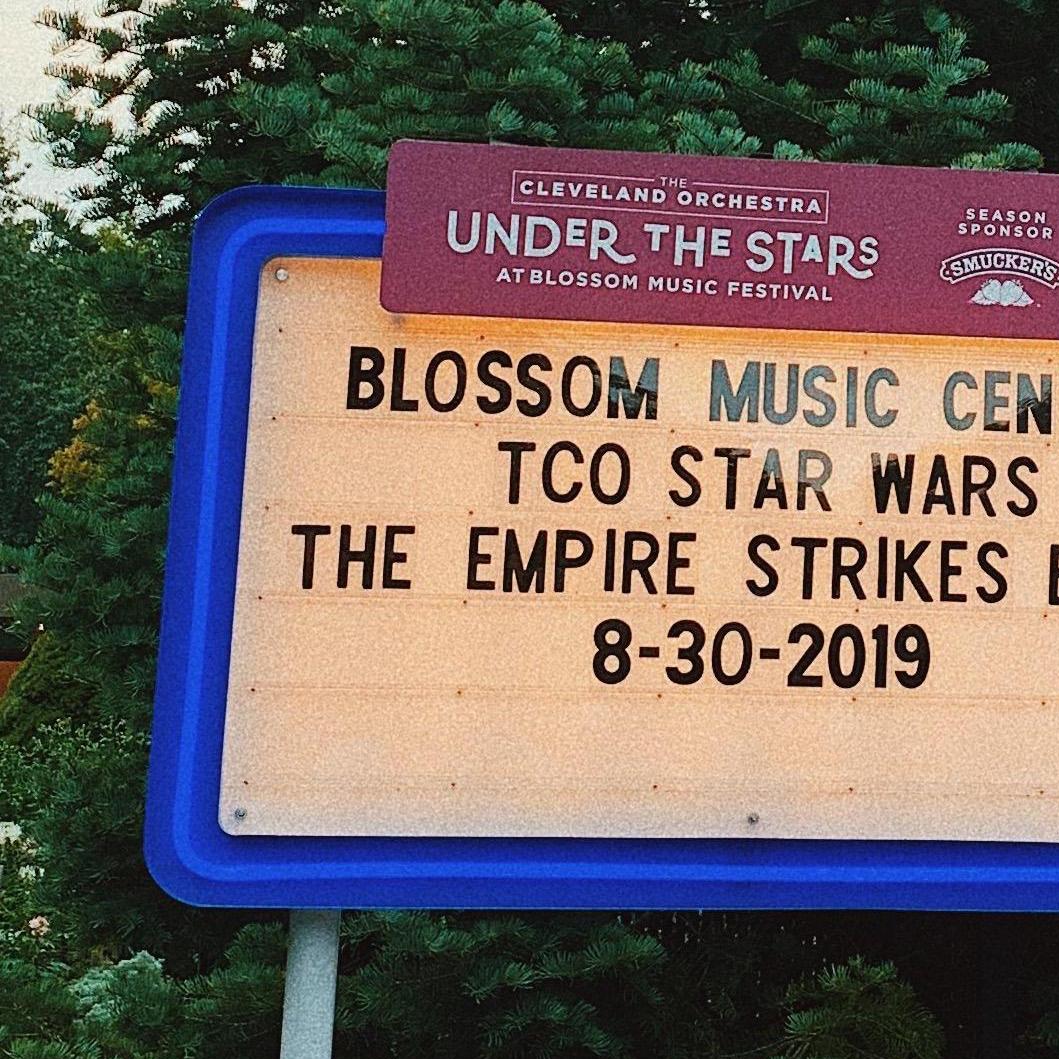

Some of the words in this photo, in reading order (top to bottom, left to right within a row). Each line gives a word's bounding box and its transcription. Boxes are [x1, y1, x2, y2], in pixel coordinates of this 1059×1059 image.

[519, 180, 666, 204] CLEVELAND
[677, 189, 822, 214] ORCHESTRA
[660, 176, 688, 188] THE
[958, 223, 1053, 239] SPONSOR
[966, 208, 1046, 224] SEASON
[446, 210, 637, 265] UNDER
[644, 223, 732, 267] THE
[746, 231, 880, 280] STARS
[950, 252, 1058, 281] SMUCKER'S
[496, 267, 522, 284] AT
[530, 270, 638, 290] BLOSSOM
[648, 276, 718, 295] MUSIC
[727, 281, 833, 301] FESTIVAL
[346, 346, 660, 420] BLOSSOM
[709, 359, 899, 428] MUSIC
[498, 440, 631, 505] TCO
[668, 445, 833, 512] STAR
[871, 452, 1039, 518] WARS
[291, 524, 415, 590] THE
[467, 526, 697, 595] EMPIRE
[746, 534, 1009, 604] STRIKES
[593, 619, 931, 689] 8-30-2019
